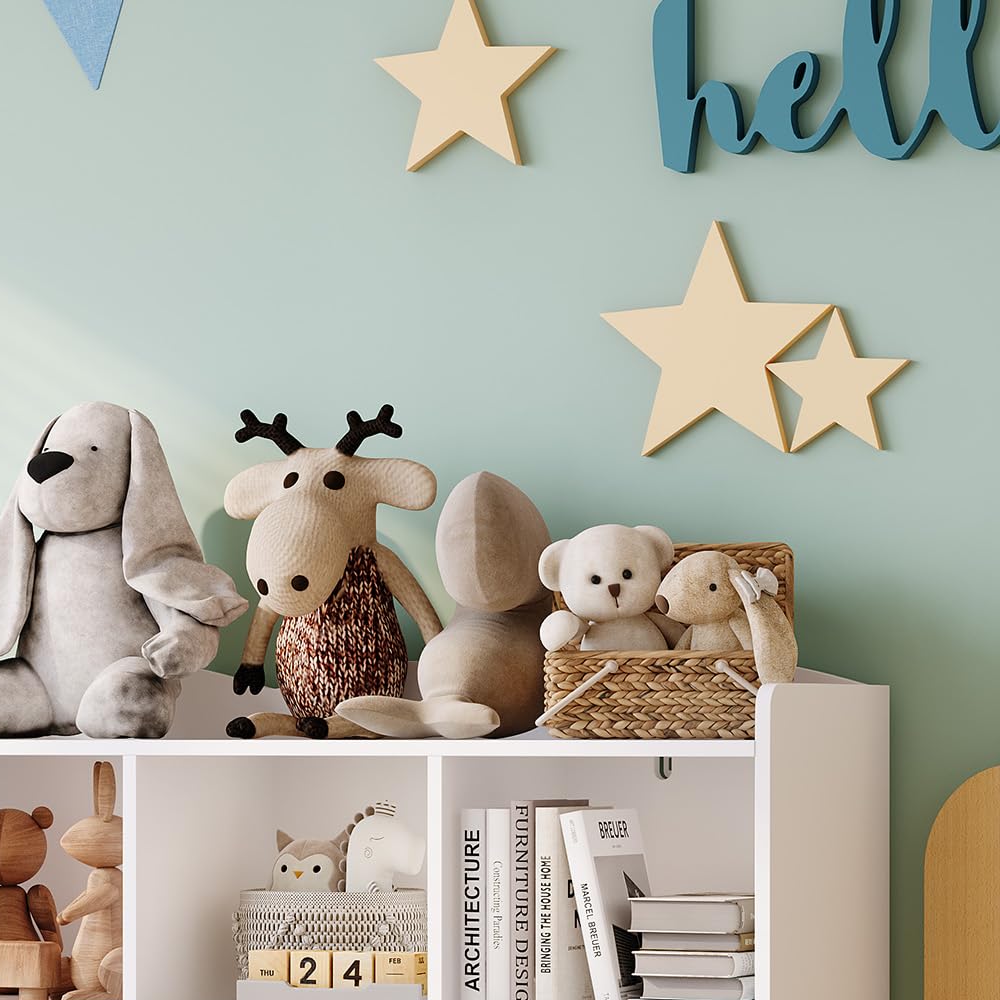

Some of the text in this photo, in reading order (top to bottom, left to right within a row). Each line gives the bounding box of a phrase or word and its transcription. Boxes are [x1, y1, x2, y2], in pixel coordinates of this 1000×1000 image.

[598, 820, 630, 839] BREUER
[515, 805, 528, 932] FURNITURE
[464, 829, 480, 992] ARCHITECTURE
[540, 855, 551, 974] BRINGING THE HOUSE HOME
[580, 883, 602, 958] MARCEL BREUER
[260, 969, 274, 977] THU
[299, 956, 316, 984] 2
[343, 960, 362, 987] 4
[389, 957, 401, 965] FEB
